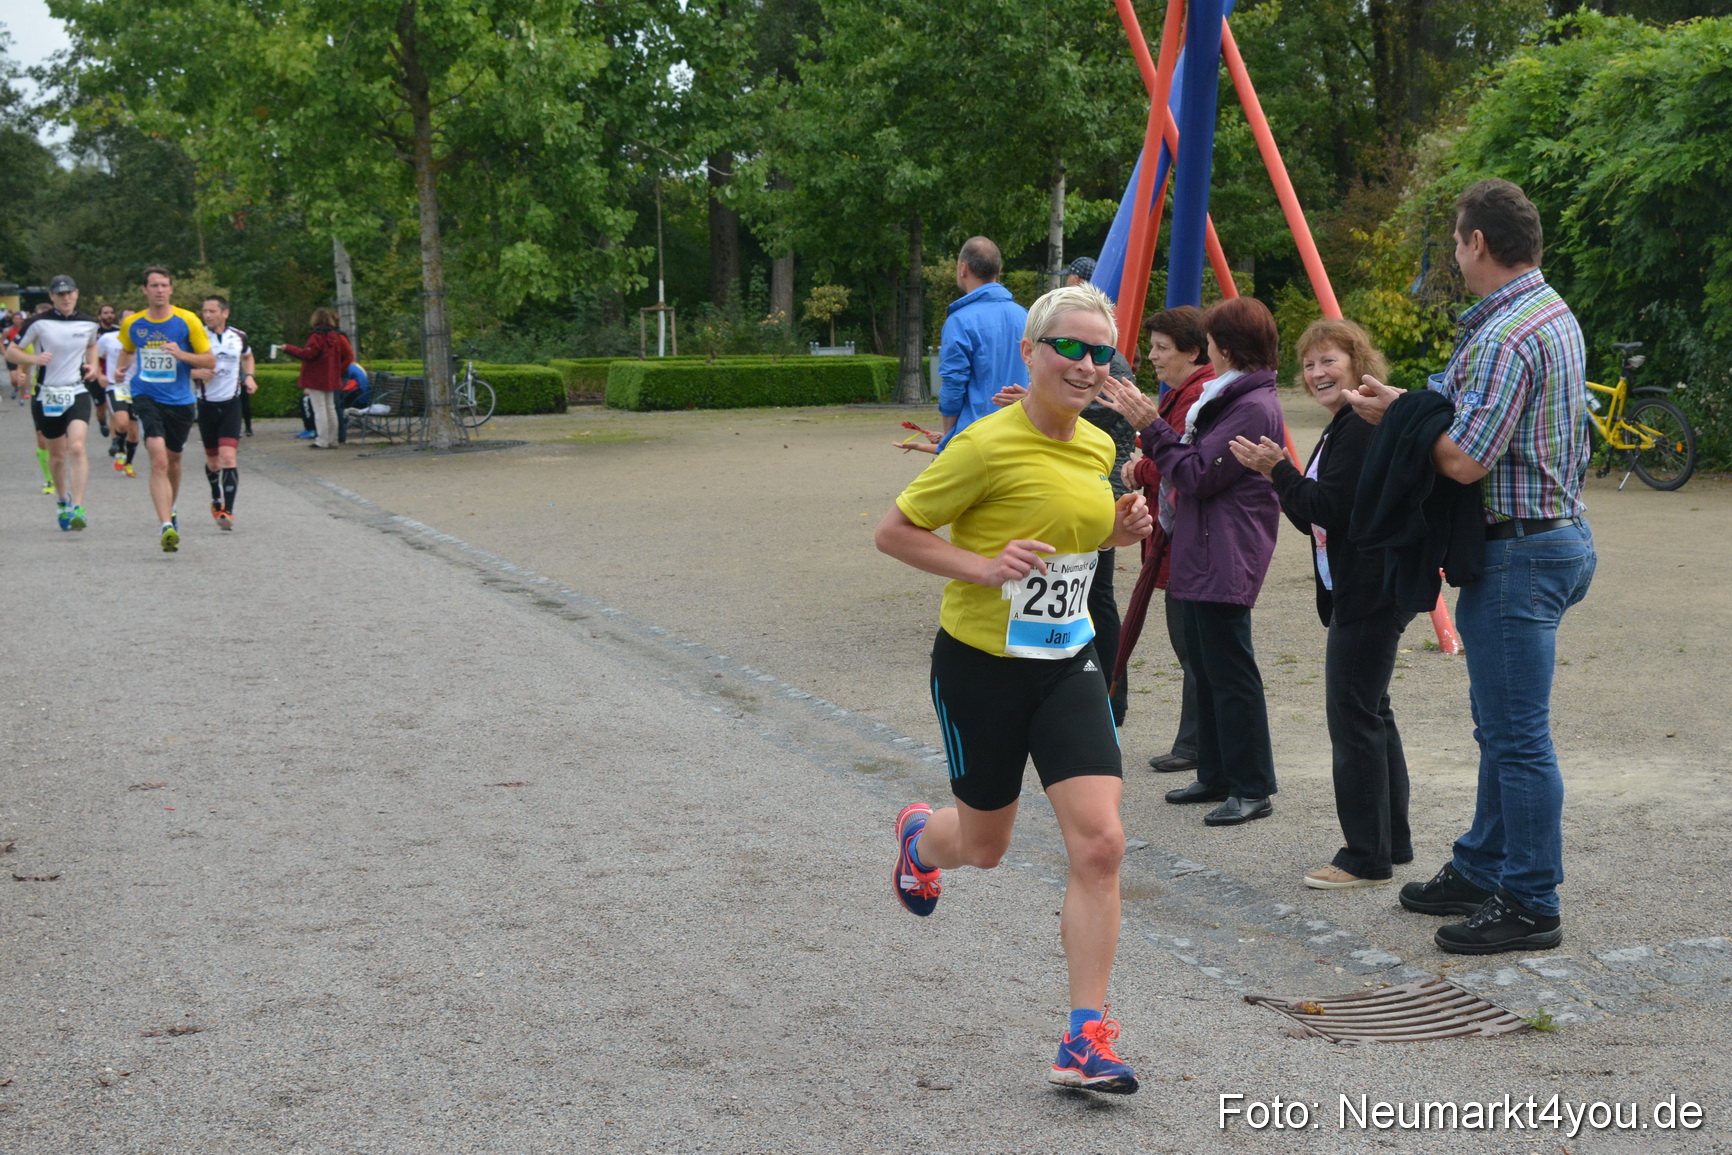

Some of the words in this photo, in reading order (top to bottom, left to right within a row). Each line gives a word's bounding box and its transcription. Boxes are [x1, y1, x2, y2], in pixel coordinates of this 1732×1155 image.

[144, 356, 173, 369] 2673
[46, 393, 72, 405] 2459
[1061, 561, 1089, 573] Neumarkt
[1023, 576, 1087, 618] 2321
